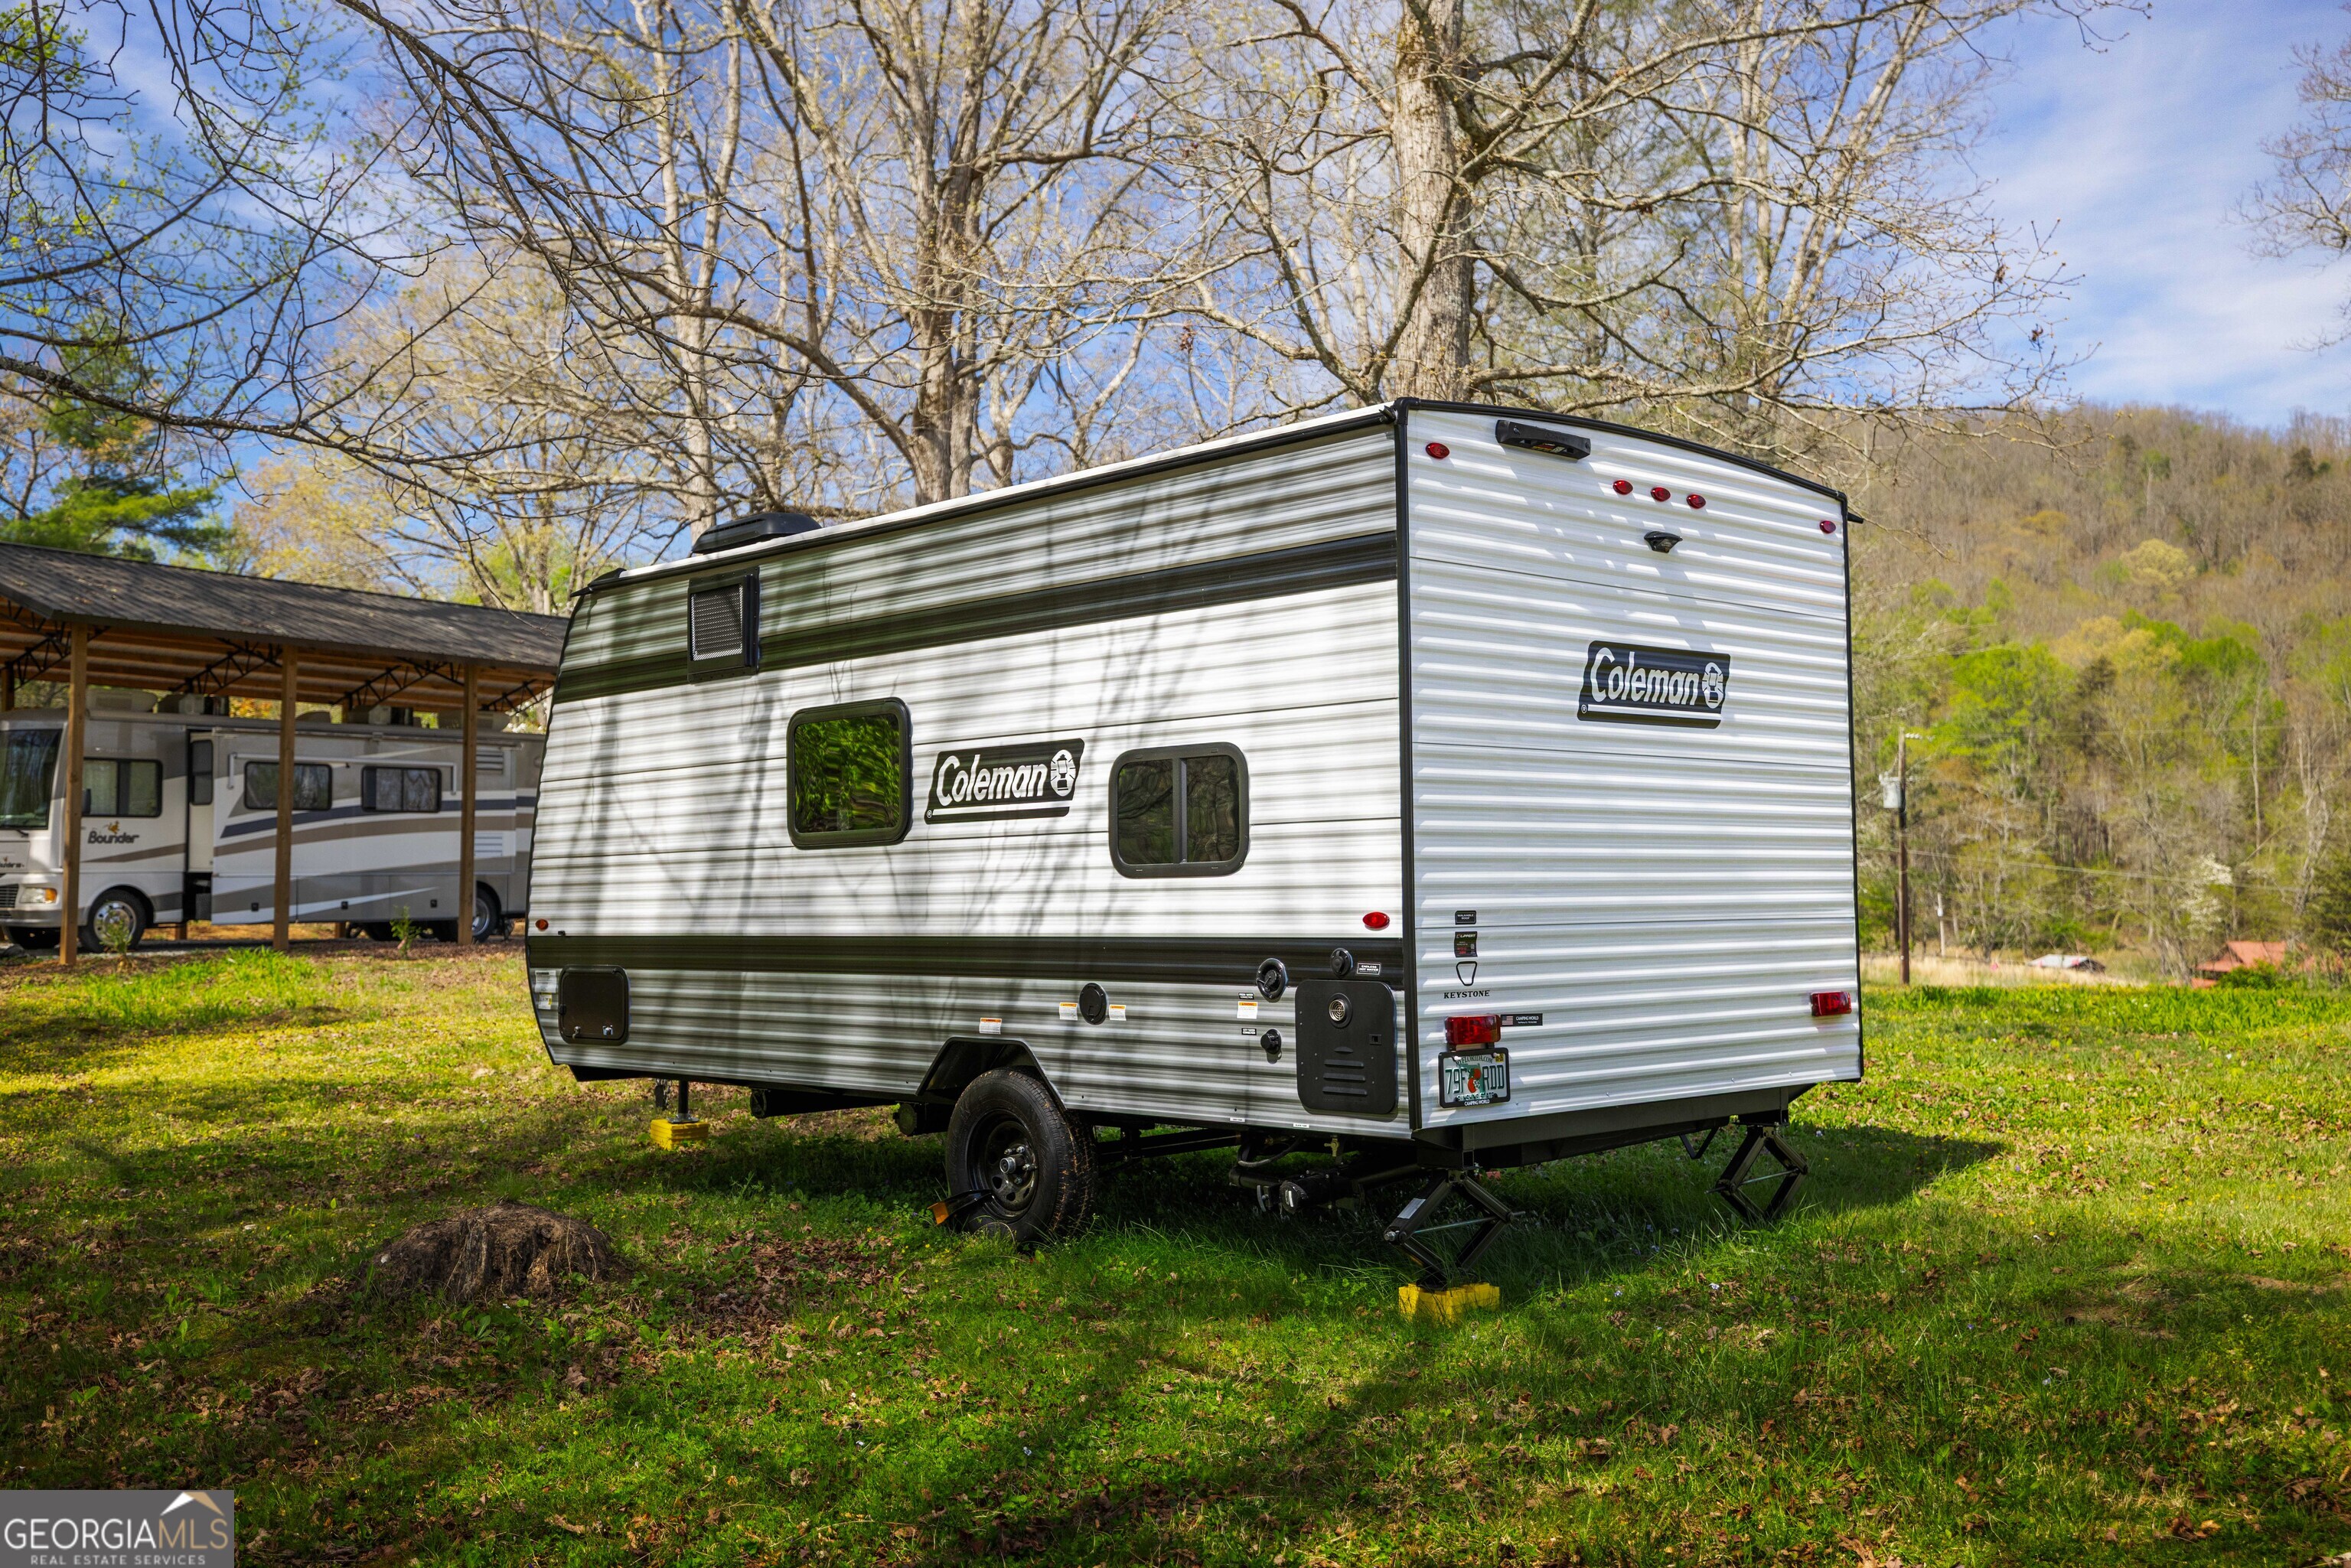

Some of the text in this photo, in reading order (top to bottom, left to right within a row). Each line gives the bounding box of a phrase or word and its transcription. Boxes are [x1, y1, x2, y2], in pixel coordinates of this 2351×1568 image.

[1590, 647, 1700, 706] Coleman
[937, 755, 1048, 807] Coleman
[87, 830, 139, 844] Bounder
[1443, 990, 1490, 999] KEYSTONE
[1445, 1064, 1505, 1094] 79F RDD
